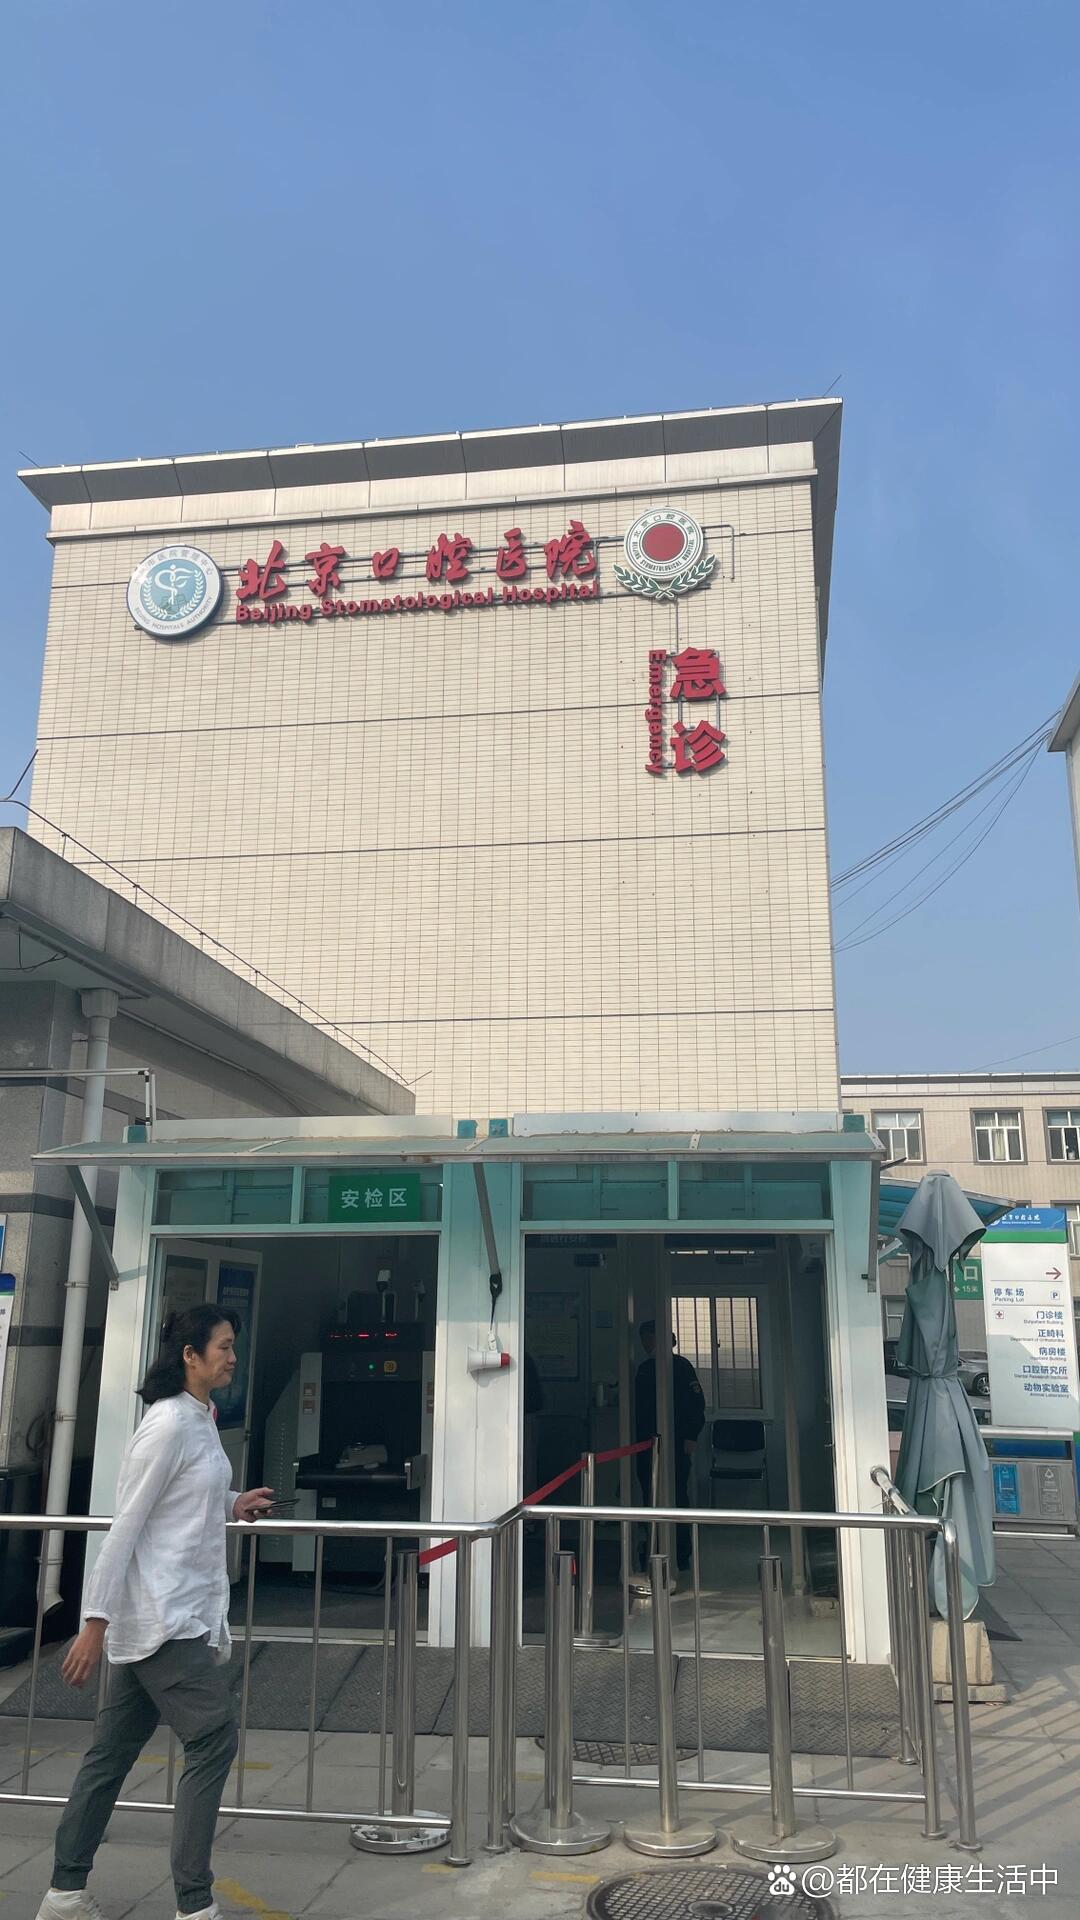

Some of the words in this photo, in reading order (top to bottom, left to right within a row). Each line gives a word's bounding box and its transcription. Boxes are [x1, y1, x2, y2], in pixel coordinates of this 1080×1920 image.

[236, 519, 598, 600] 北京口腔医院
[187, 596, 213, 624] AUTHORITY
[236, 603, 312, 624] Beijing
[320, 588, 493, 615] Stomatological
[502, 580, 598, 603] Hospital
[645, 649, 667, 774] Emergency
[670, 647, 727, 773] 急诊
[341, 1187, 408, 1209] 安检区
[993, 1287, 1025, 1297] 停车场
[1036, 1310, 1063, 1320] 门诊楼
[1038, 1329, 1064, 1338] 正畸科
[1039, 1347, 1066, 1356] 病房楼
[1023, 1365, 1067, 1375] 口腔研究所
[1024, 1383, 1069, 1393] 动物实验室
